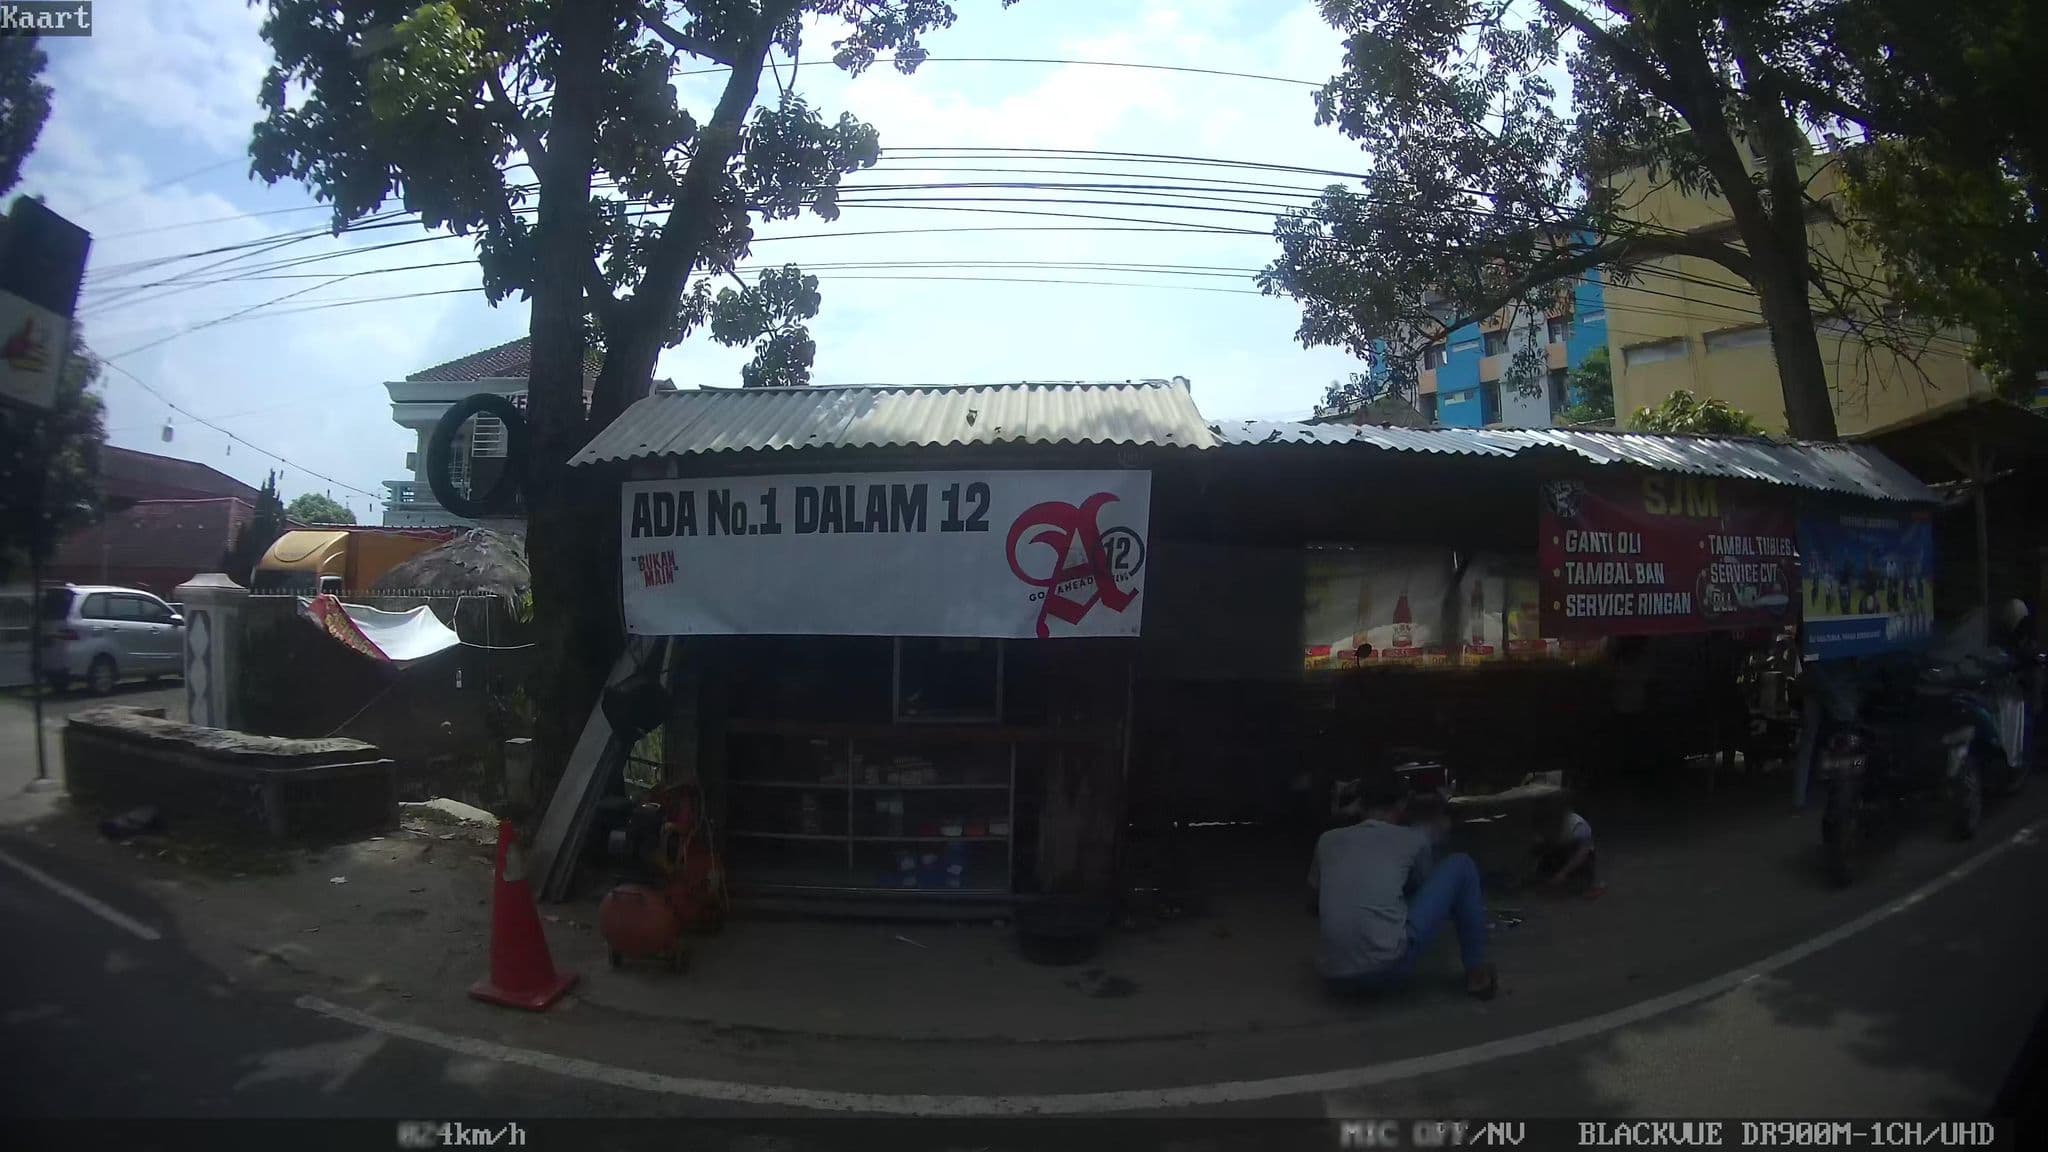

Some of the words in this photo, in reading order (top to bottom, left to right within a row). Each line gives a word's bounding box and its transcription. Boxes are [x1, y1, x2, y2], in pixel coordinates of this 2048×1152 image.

[630, 491, 698, 538] ADA
[707, 487, 782, 536] No.1
[795, 483, 928, 534] DALAM
[940, 481, 990, 532] 12
[1565, 529, 1613, 553] GANTI
[1617, 531, 1641, 554] OLI
[1708, 534, 1755, 556] TAMBAL
[1565, 561, 1633, 585] TAMBAL
[1636, 562, 1665, 585] BAN
[1710, 562, 1758, 584] SERVICE
[1760, 563, 1778, 583] CVT
[1029, 591, 1046, 602] GO
[1056, 576, 1094, 595] AHEAD
[1566, 593, 1634, 617] SERVICE
[1638, 592, 1692, 616] RINGAN
